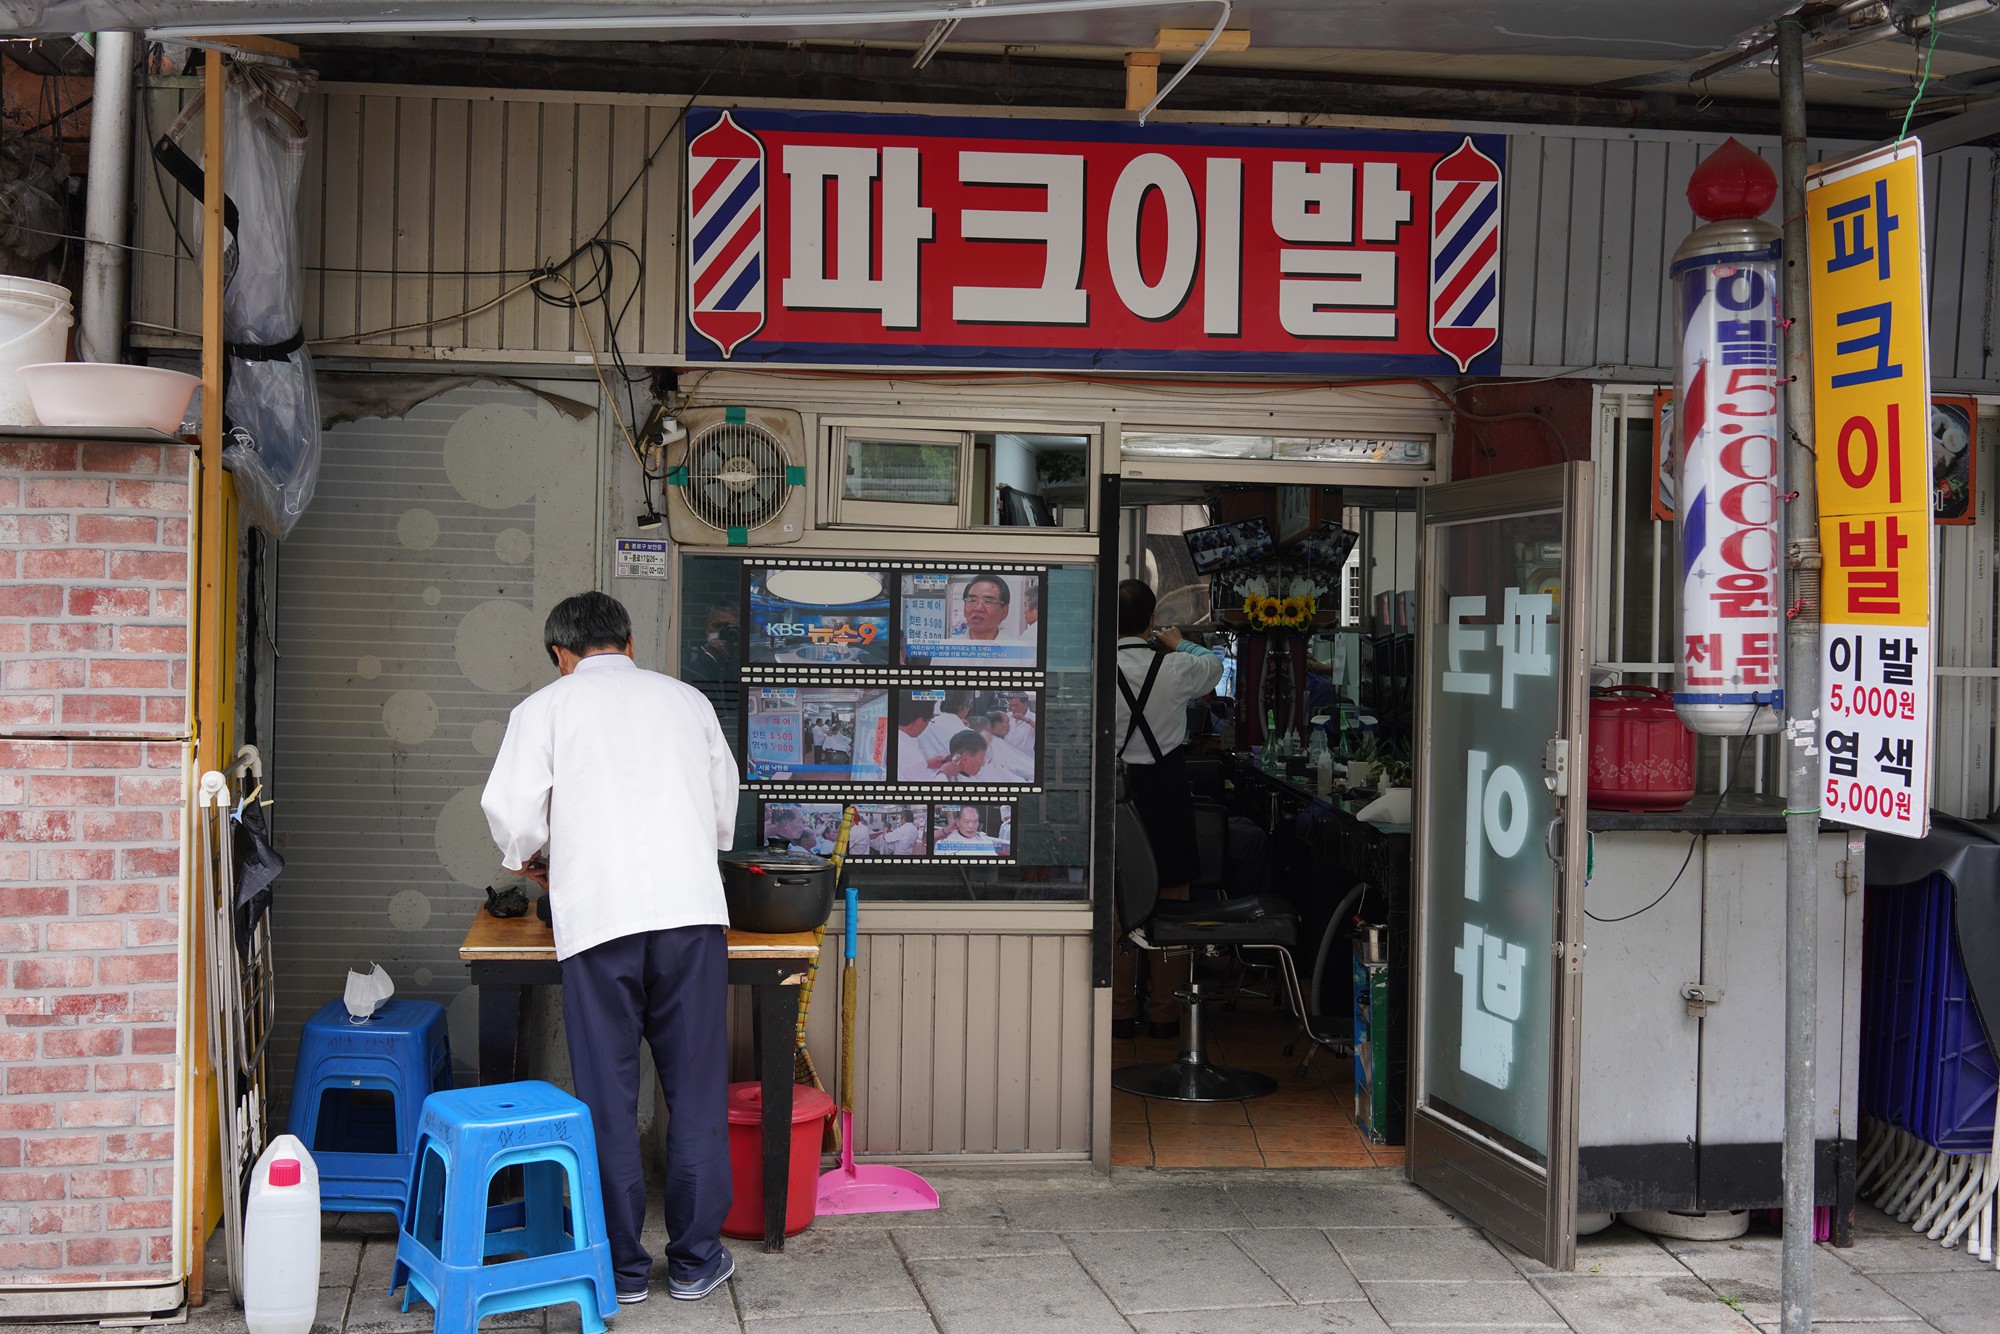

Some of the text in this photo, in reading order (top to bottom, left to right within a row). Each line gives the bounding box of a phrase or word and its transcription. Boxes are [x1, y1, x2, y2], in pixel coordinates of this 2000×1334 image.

[782, 145, 1412, 338] 파크이발
[1826, 178, 1909, 614] 파크이발
[767, 621, 806, 638] KBS
[1685, 633, 1778, 686] 전문
[1830, 683, 1915, 720] 5,000원
[1826, 778, 1911, 821] 5,000원
